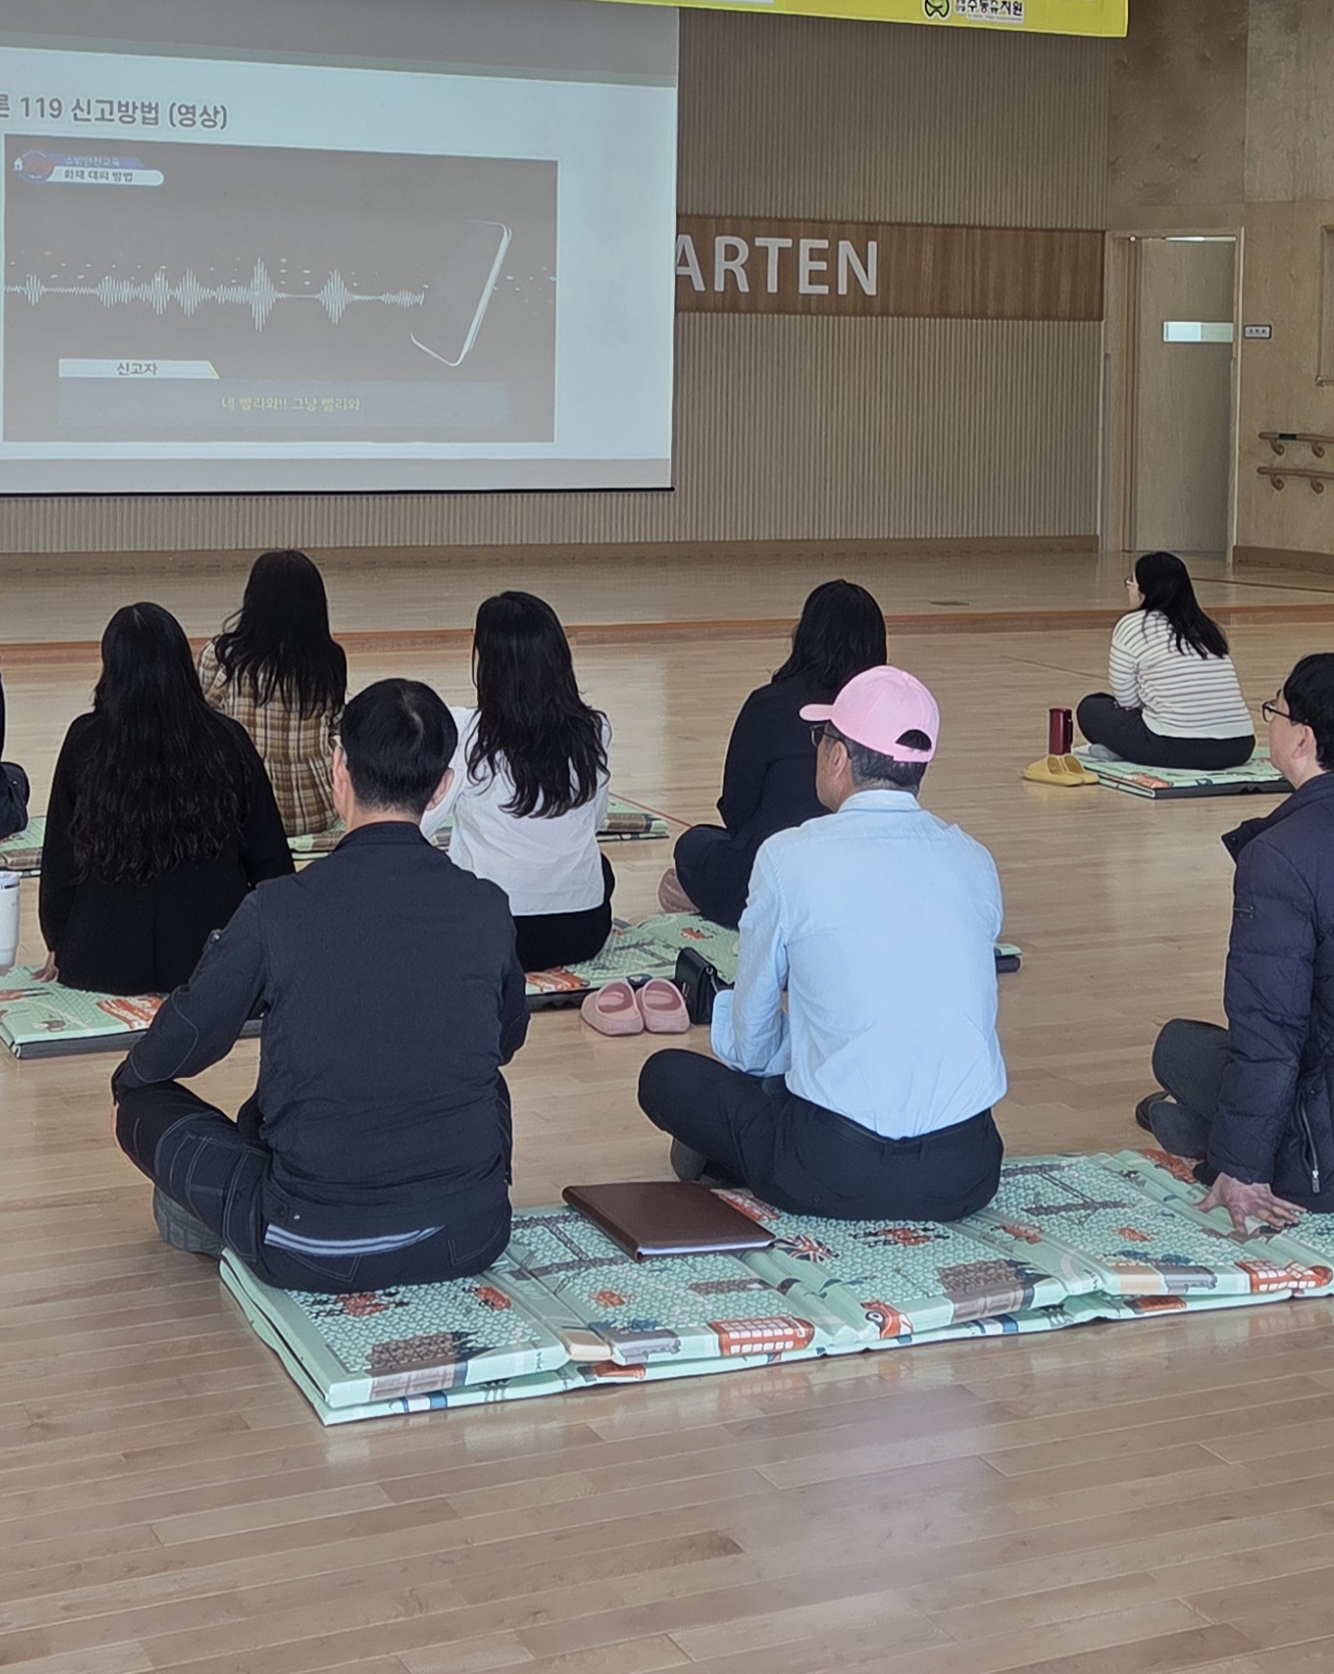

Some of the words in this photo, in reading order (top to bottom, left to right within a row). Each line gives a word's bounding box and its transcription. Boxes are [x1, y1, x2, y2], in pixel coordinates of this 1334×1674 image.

[20, 96, 64, 119] 119
[71, 98, 160, 126] 신고방법
[168, 101, 228, 130] (영상)
[116, 361, 158, 377] 신고자
